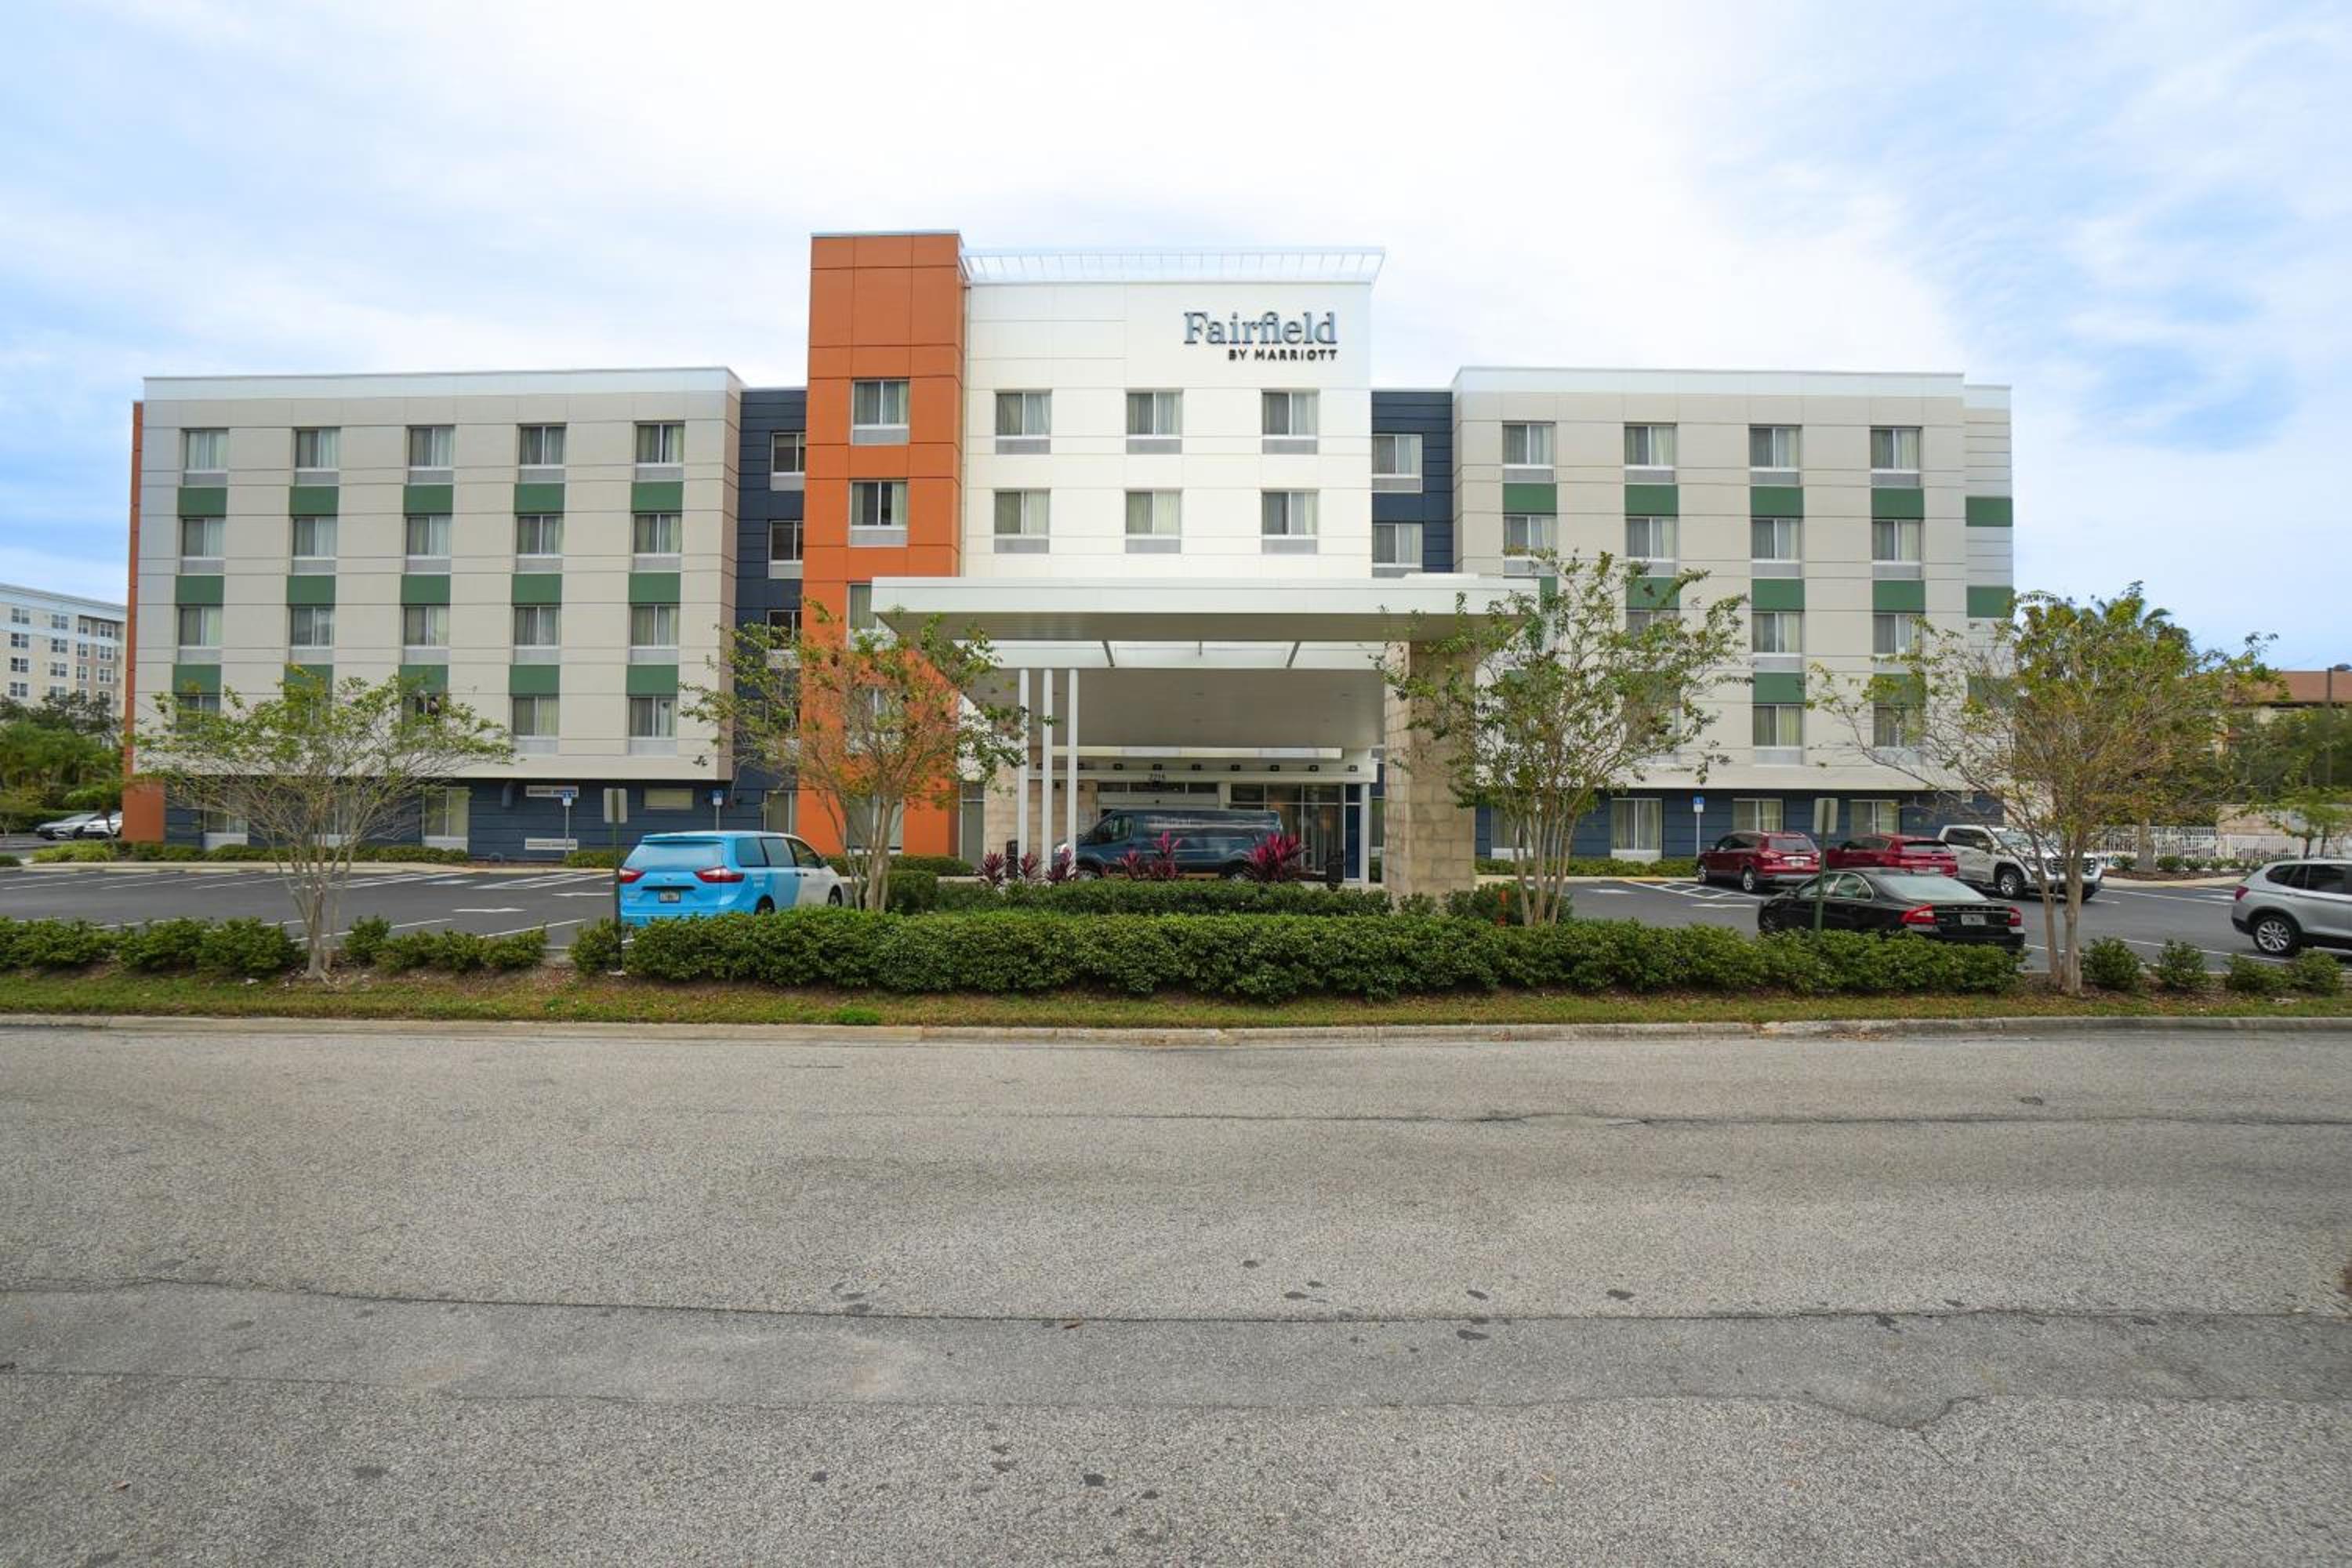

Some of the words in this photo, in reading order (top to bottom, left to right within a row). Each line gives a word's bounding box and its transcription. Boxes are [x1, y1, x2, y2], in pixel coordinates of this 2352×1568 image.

[1184, 312, 1337, 344] Fairfield
[1229, 349, 1247, 361] BY
[1255, 349, 1338, 361] MARRIOTT
